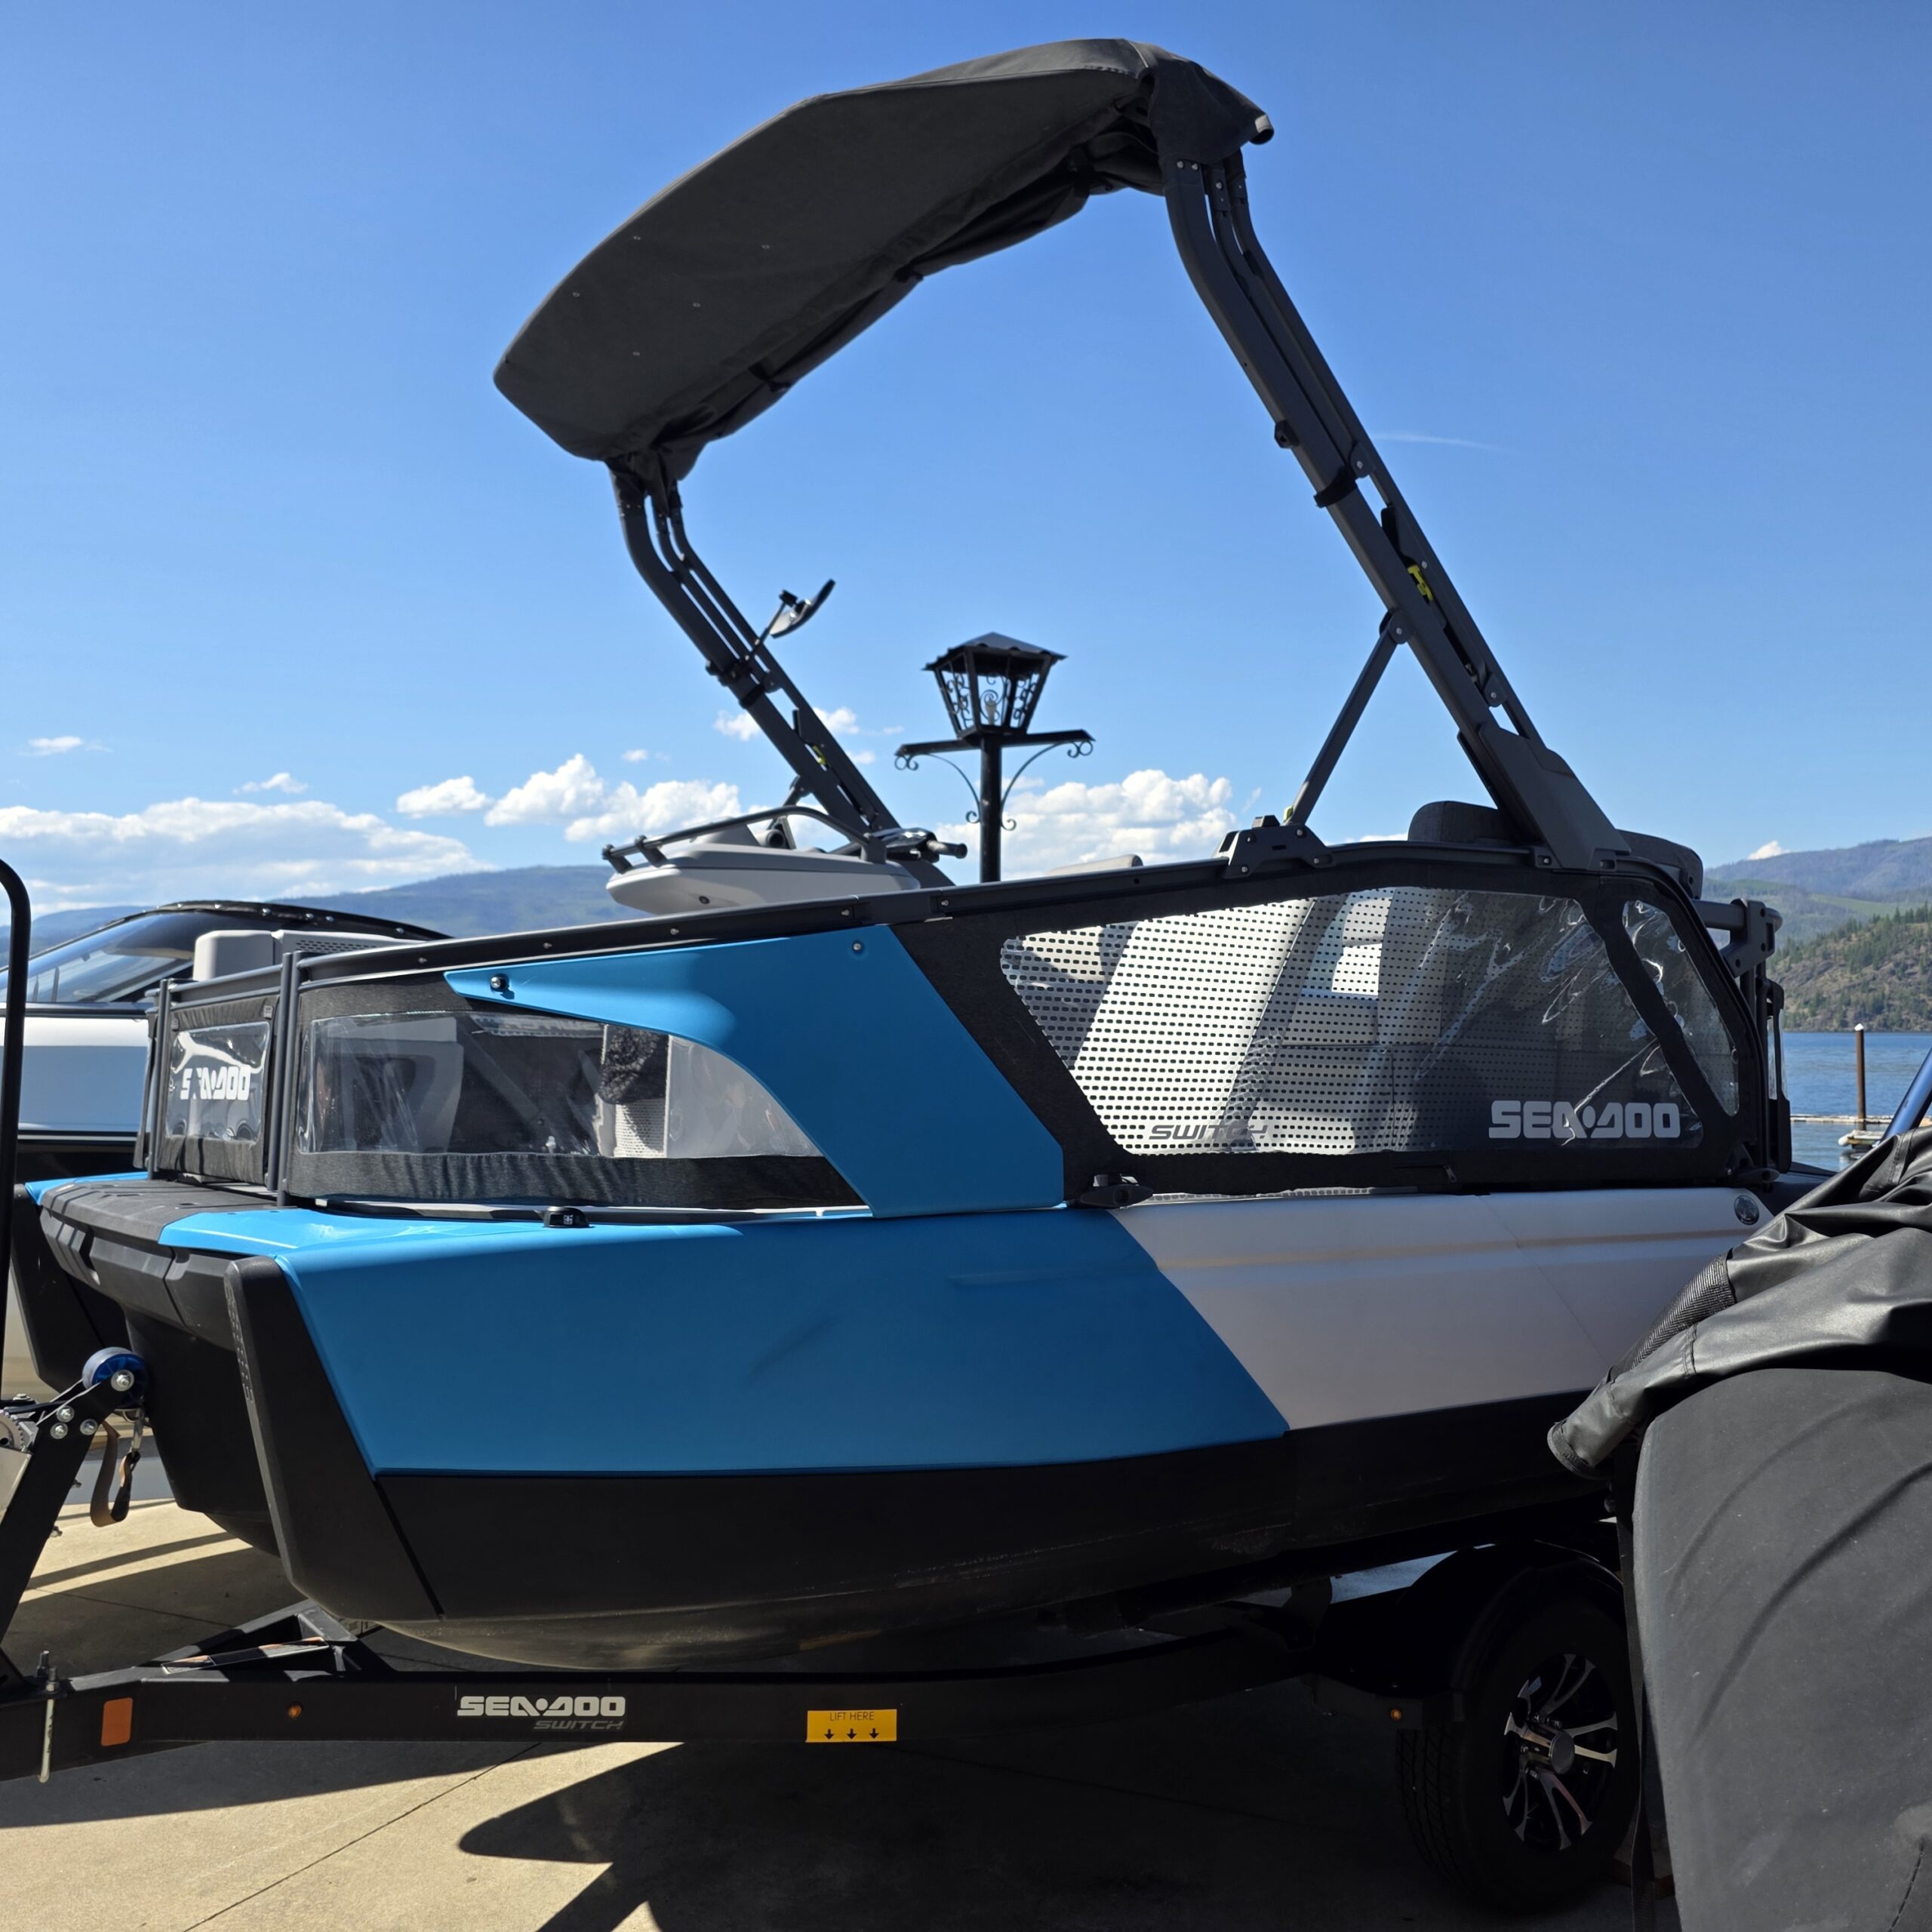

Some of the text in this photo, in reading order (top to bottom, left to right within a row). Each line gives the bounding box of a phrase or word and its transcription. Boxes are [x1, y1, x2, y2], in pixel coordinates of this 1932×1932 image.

[1149, 1124, 1268, 1140] SWITCH
[829, 1711, 875, 1721] LIFT HERE
[534, 1720, 625, 1730] SWITCH
